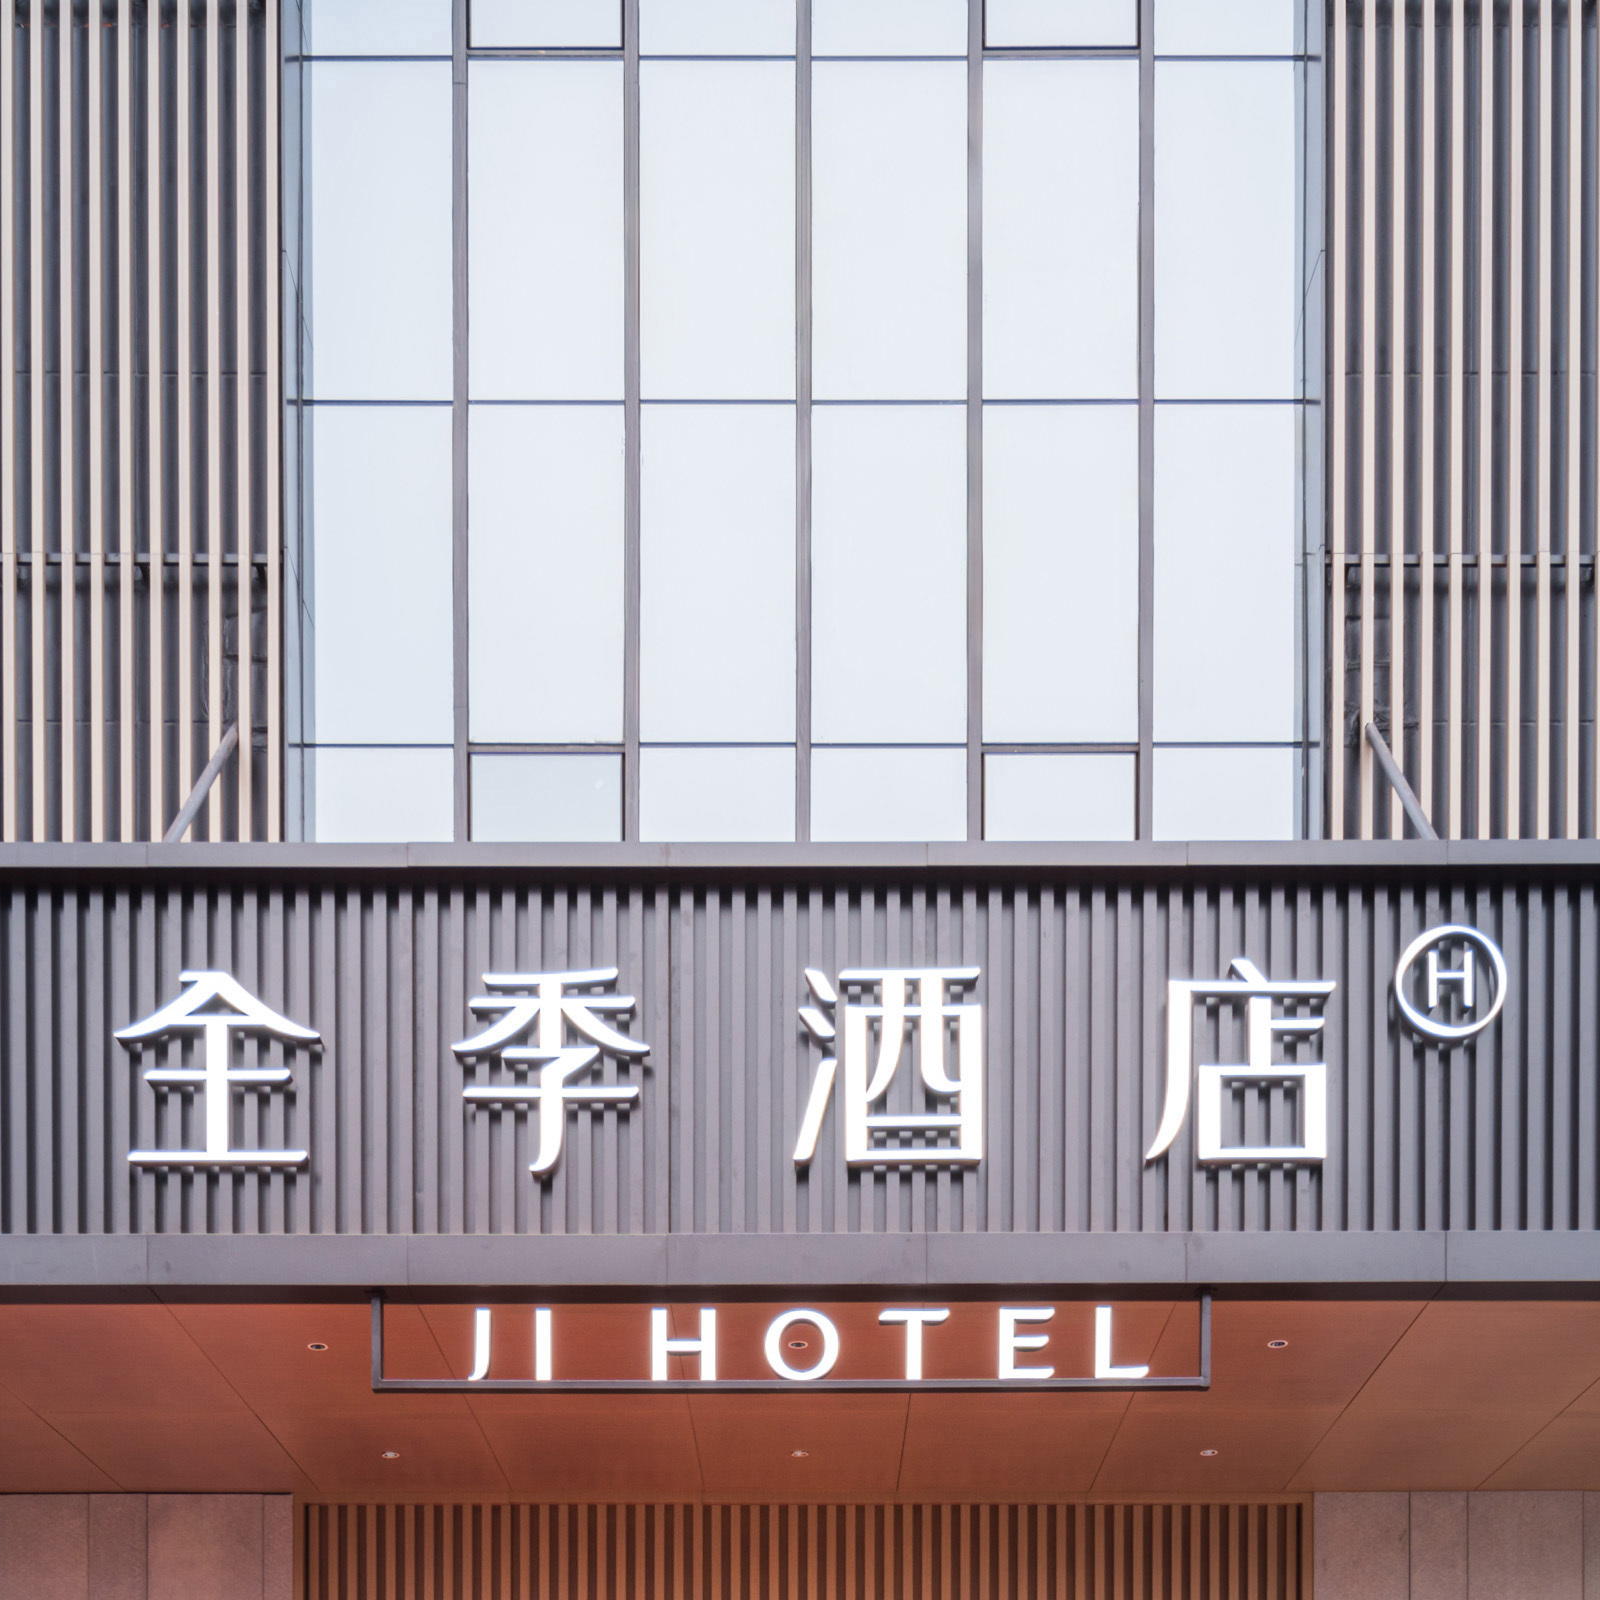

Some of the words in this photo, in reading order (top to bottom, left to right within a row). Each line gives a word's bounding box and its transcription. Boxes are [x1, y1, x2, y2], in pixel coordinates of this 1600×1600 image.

[112, 957, 1338, 1173] 全季酒店
[467, 1308, 553, 1382] JI
[650, 1307, 1151, 1382] HOTEL
